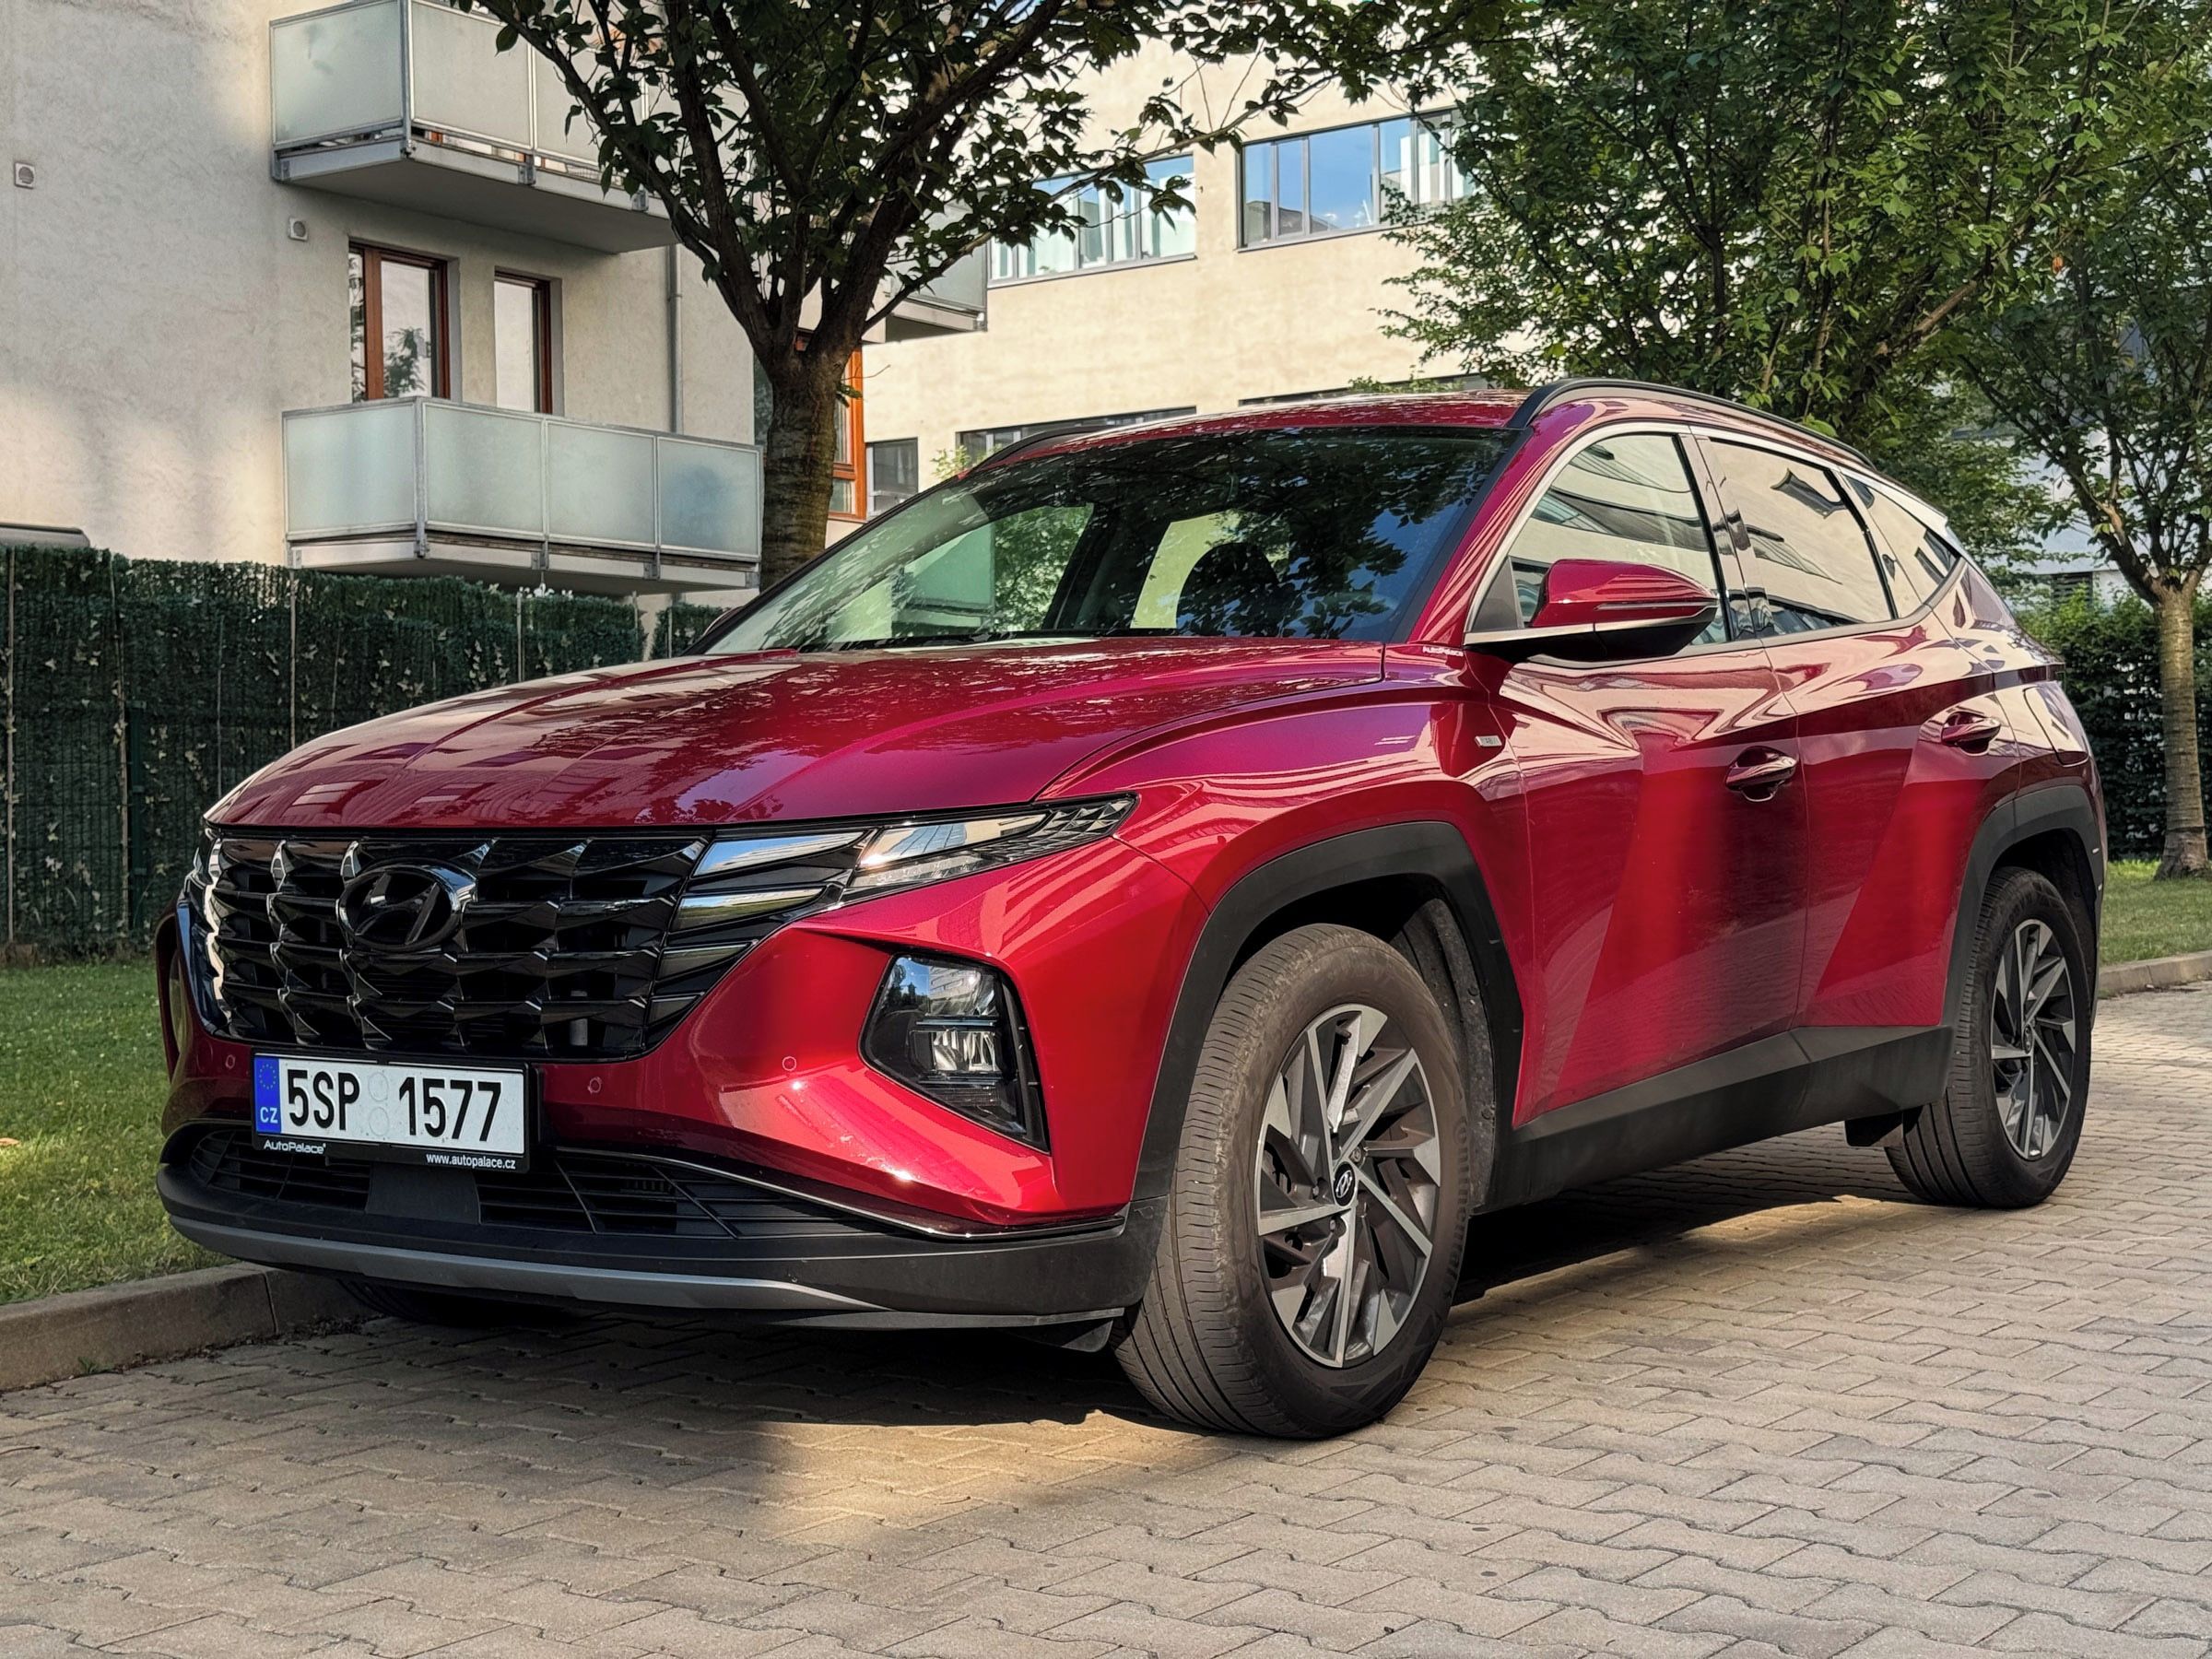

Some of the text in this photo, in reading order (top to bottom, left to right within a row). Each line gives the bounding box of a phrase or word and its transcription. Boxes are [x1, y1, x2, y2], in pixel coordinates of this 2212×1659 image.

[287, 1068, 502, 1142] 5SP 1577
[260, 1106, 278, 1124] CZ
[264, 1139, 324, 1154] AutoPalace
[426, 1153, 516, 1170] www.autopalace.cz
